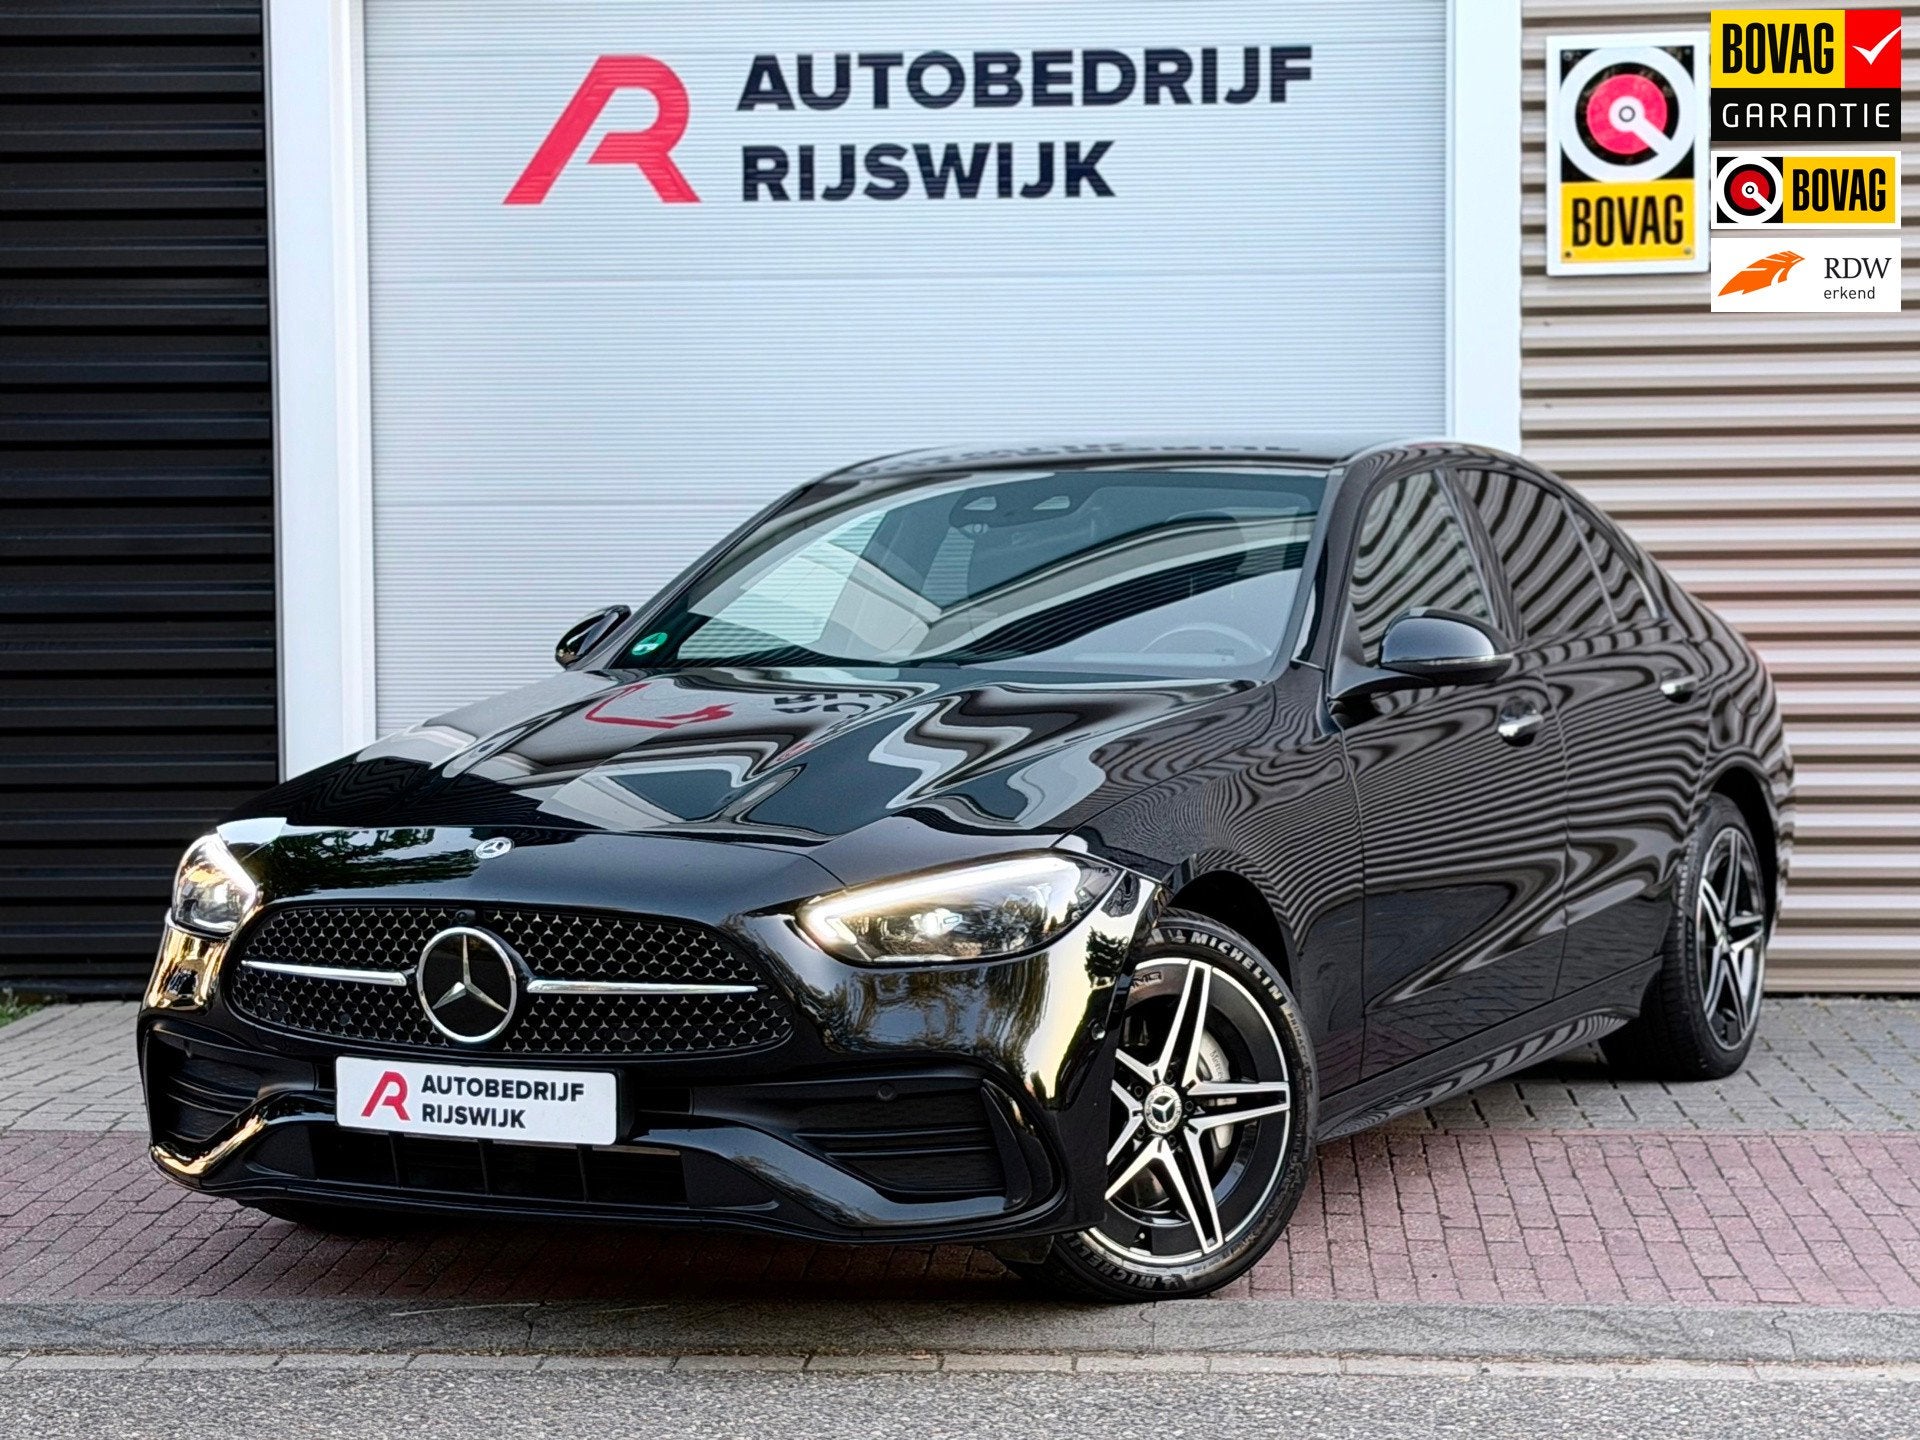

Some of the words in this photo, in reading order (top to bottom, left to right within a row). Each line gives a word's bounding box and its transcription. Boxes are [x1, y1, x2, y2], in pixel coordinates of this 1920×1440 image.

[737, 46, 1312, 111] AUTOBEDRIJF
[742, 140, 1116, 202] RIJSWIJK
[1571, 193, 1684, 248] BOVAG
[1190, 931, 1283, 1000] MICHELIN
[421, 1074, 585, 1102] AUTOBEDRIJF
[422, 1103, 526, 1129] RIJSWIJK
